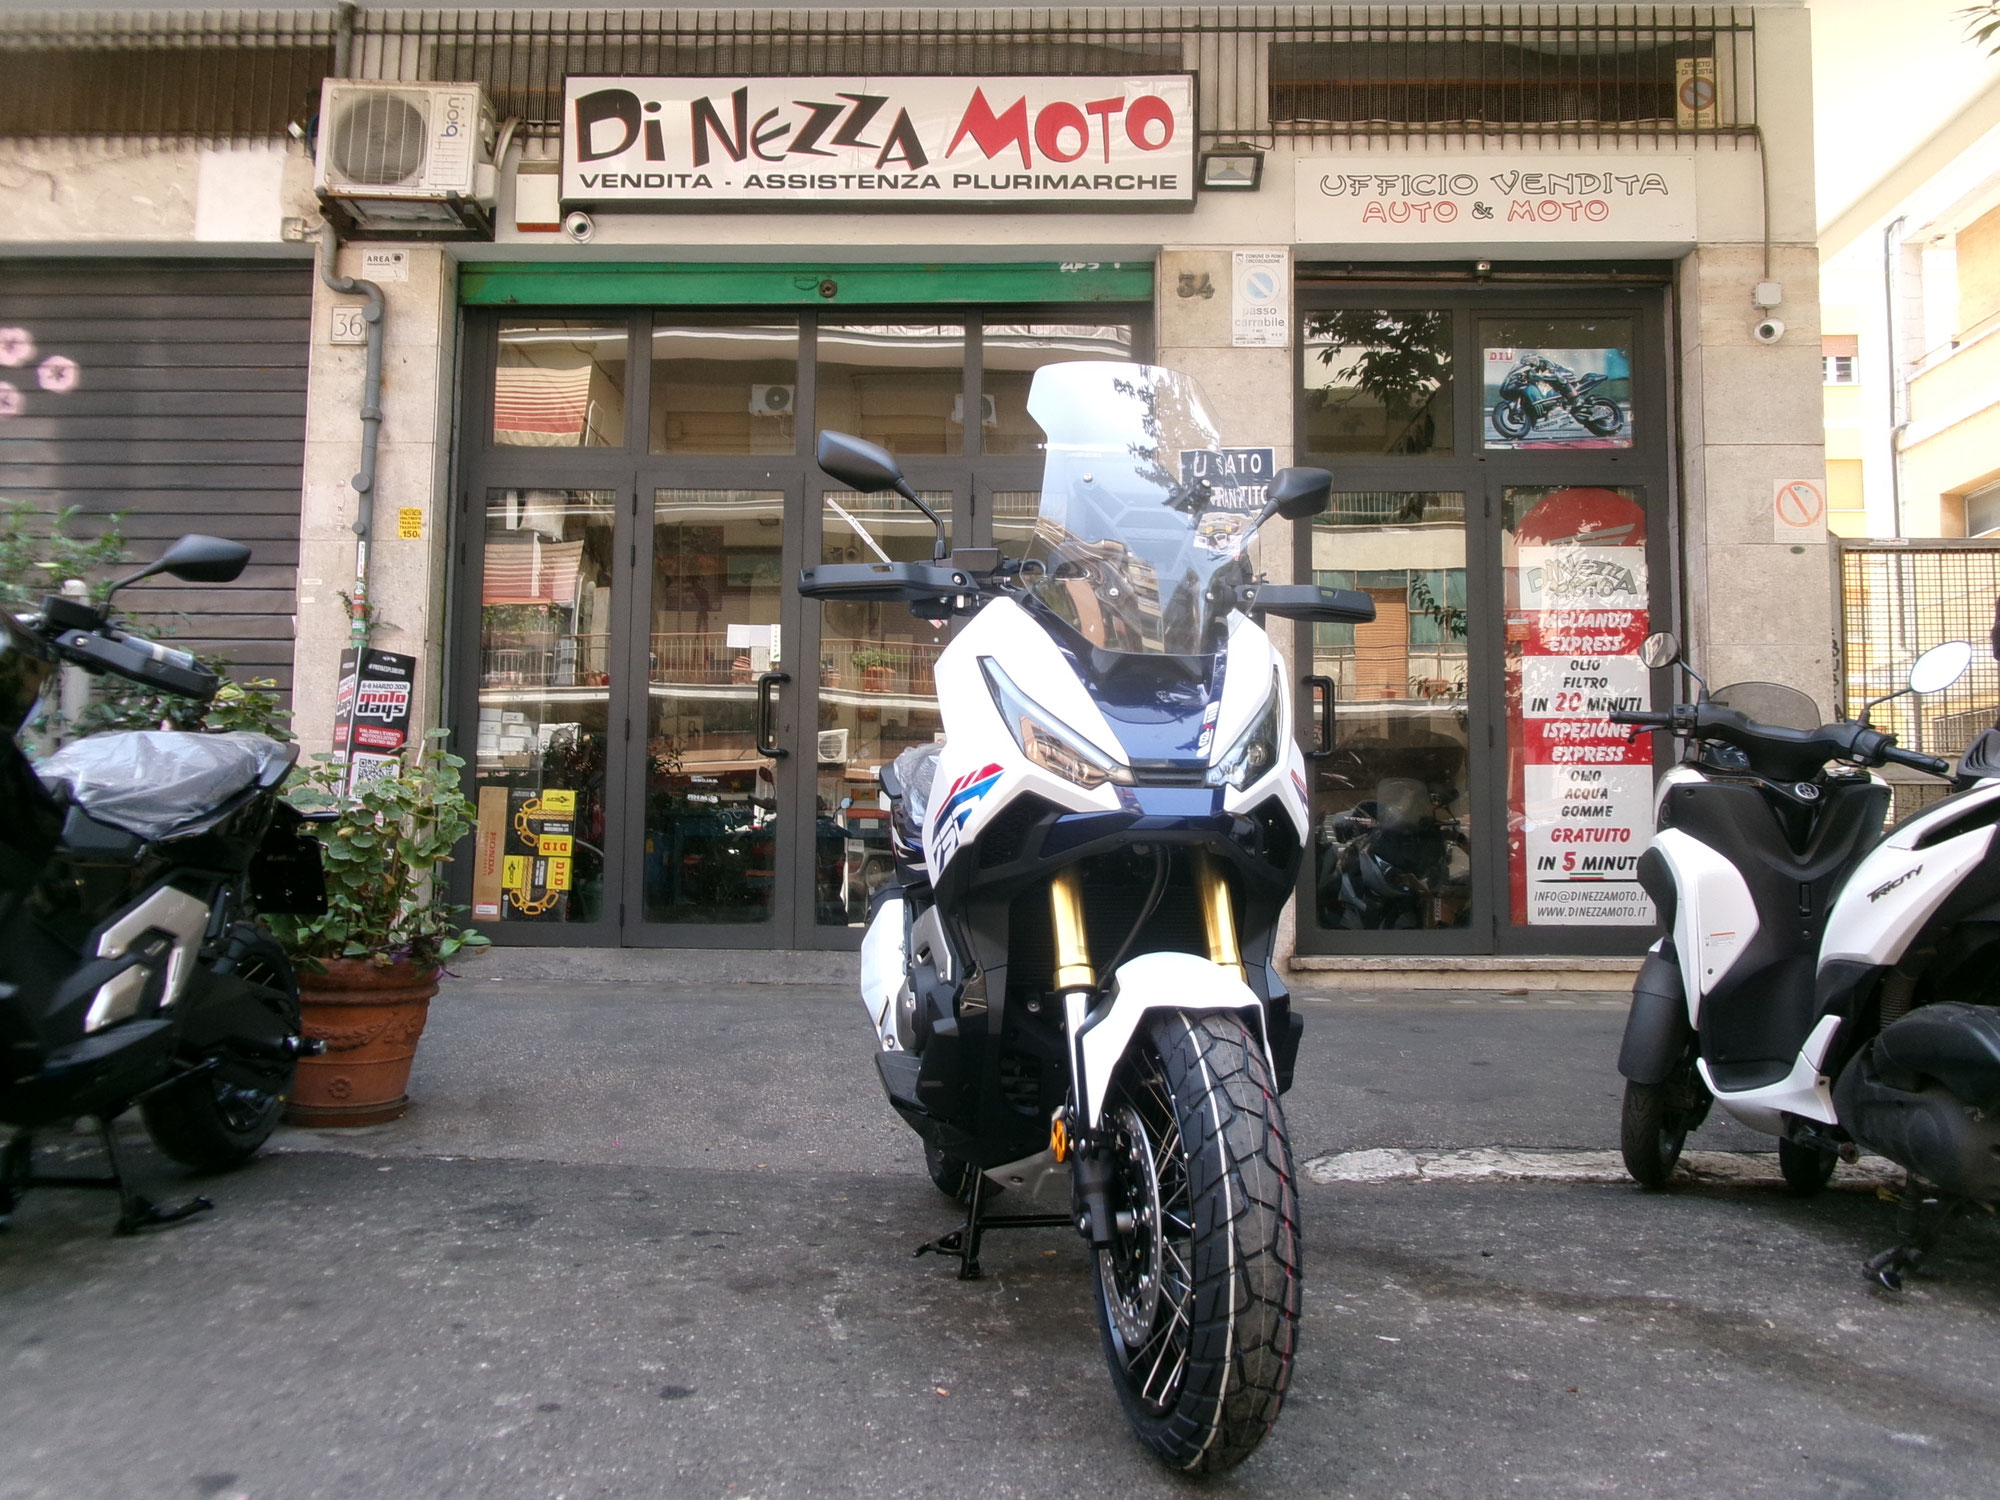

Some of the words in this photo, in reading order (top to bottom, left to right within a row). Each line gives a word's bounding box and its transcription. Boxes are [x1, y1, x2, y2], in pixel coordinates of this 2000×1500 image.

[945, 85, 1174, 170] MOTO
[579, 173, 713, 188] VENDITA
[743, 174, 941, 189] ASSISTENZA
[953, 174, 1178, 190] PLURIMARCHE
[1320, 173, 1479, 197] UFFICIO
[1490, 169, 1669, 196] VENDITA
[1362, 200, 1459, 223] AUTO
[1472, 201, 1495, 220] &
[1507, 199, 1610, 222] MOTO
[367, 255, 390, 263] AREA
[1177, 272, 1215, 299] 34
[1243, 307, 1277, 317] passo
[335, 313, 363, 337] 36
[1235, 319, 1285, 327] carrabile
[1537, 613, 1632, 629] TAGLIANDO
[1549, 636, 1623, 653] EXPRESS
[1570, 660, 1601, 671] OLIO
[1563, 677, 1608, 689] FILTRO
[1531, 698, 1549, 712] IN
[1555, 692, 1582, 712] 20
[1587, 697, 1642, 712] MINUTI
[358, 704, 405, 719] days
[1542, 722, 1632, 738] ISPEZIONE
[1552, 746, 1625, 762] EXPRESS
[1564, 788, 1608, 799] ACQUA
[1562, 806, 1613, 817] GOMME
[1551, 828, 1631, 843] GRATUITO
[487, 831, 497, 876] HONDA
[1537, 856, 1556, 871] IN
[1562, 851, 1576, 872] 5
[1534, 890, 1649, 903] INFO@DINEZZAMOTO.IT
[1537, 906, 1648, 917] WWW.DINEZZAMOTO.IT
